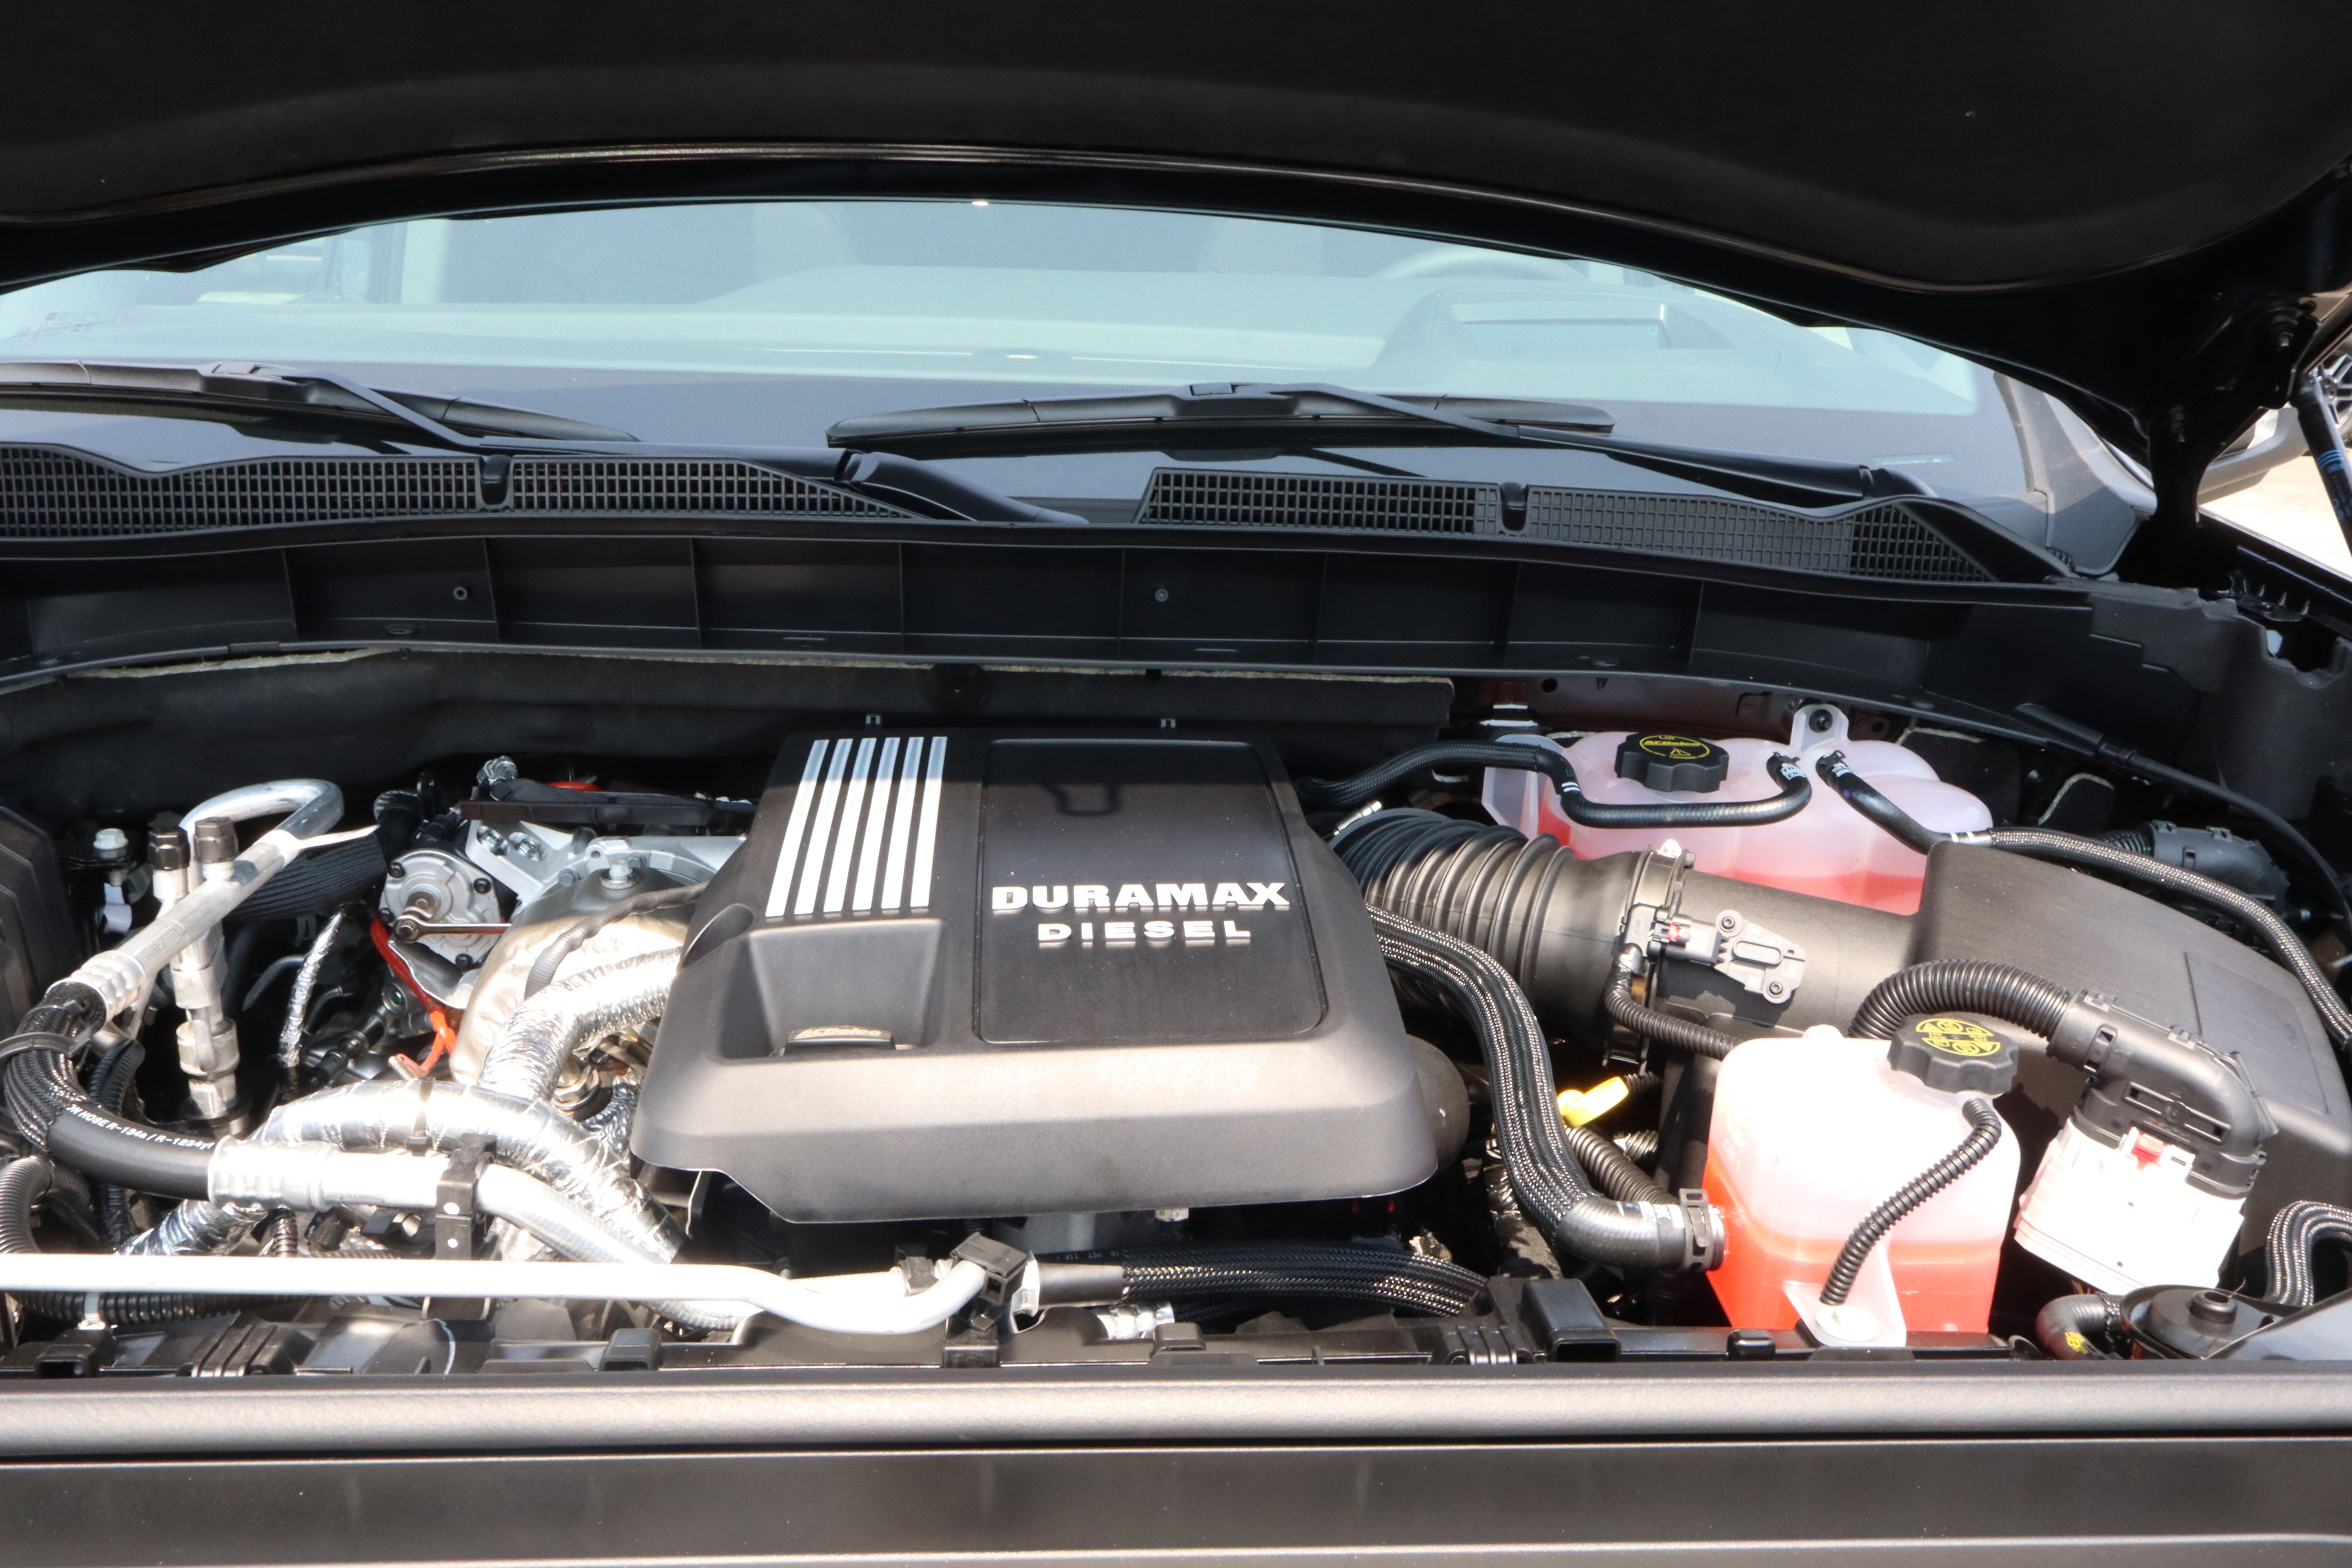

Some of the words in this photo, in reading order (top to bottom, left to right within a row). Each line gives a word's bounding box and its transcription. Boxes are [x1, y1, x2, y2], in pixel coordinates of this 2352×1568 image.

[992, 882, 1290, 910] DURAMAX
[1038, 920, 1251, 942] DIESEL
[794, 1027, 881, 1039] ACDelco
[78, 1111, 111, 1127] HOSE
[106, 1122, 148, 1139] R-134a
[155, 1134, 215, 1150] R-1234yf
